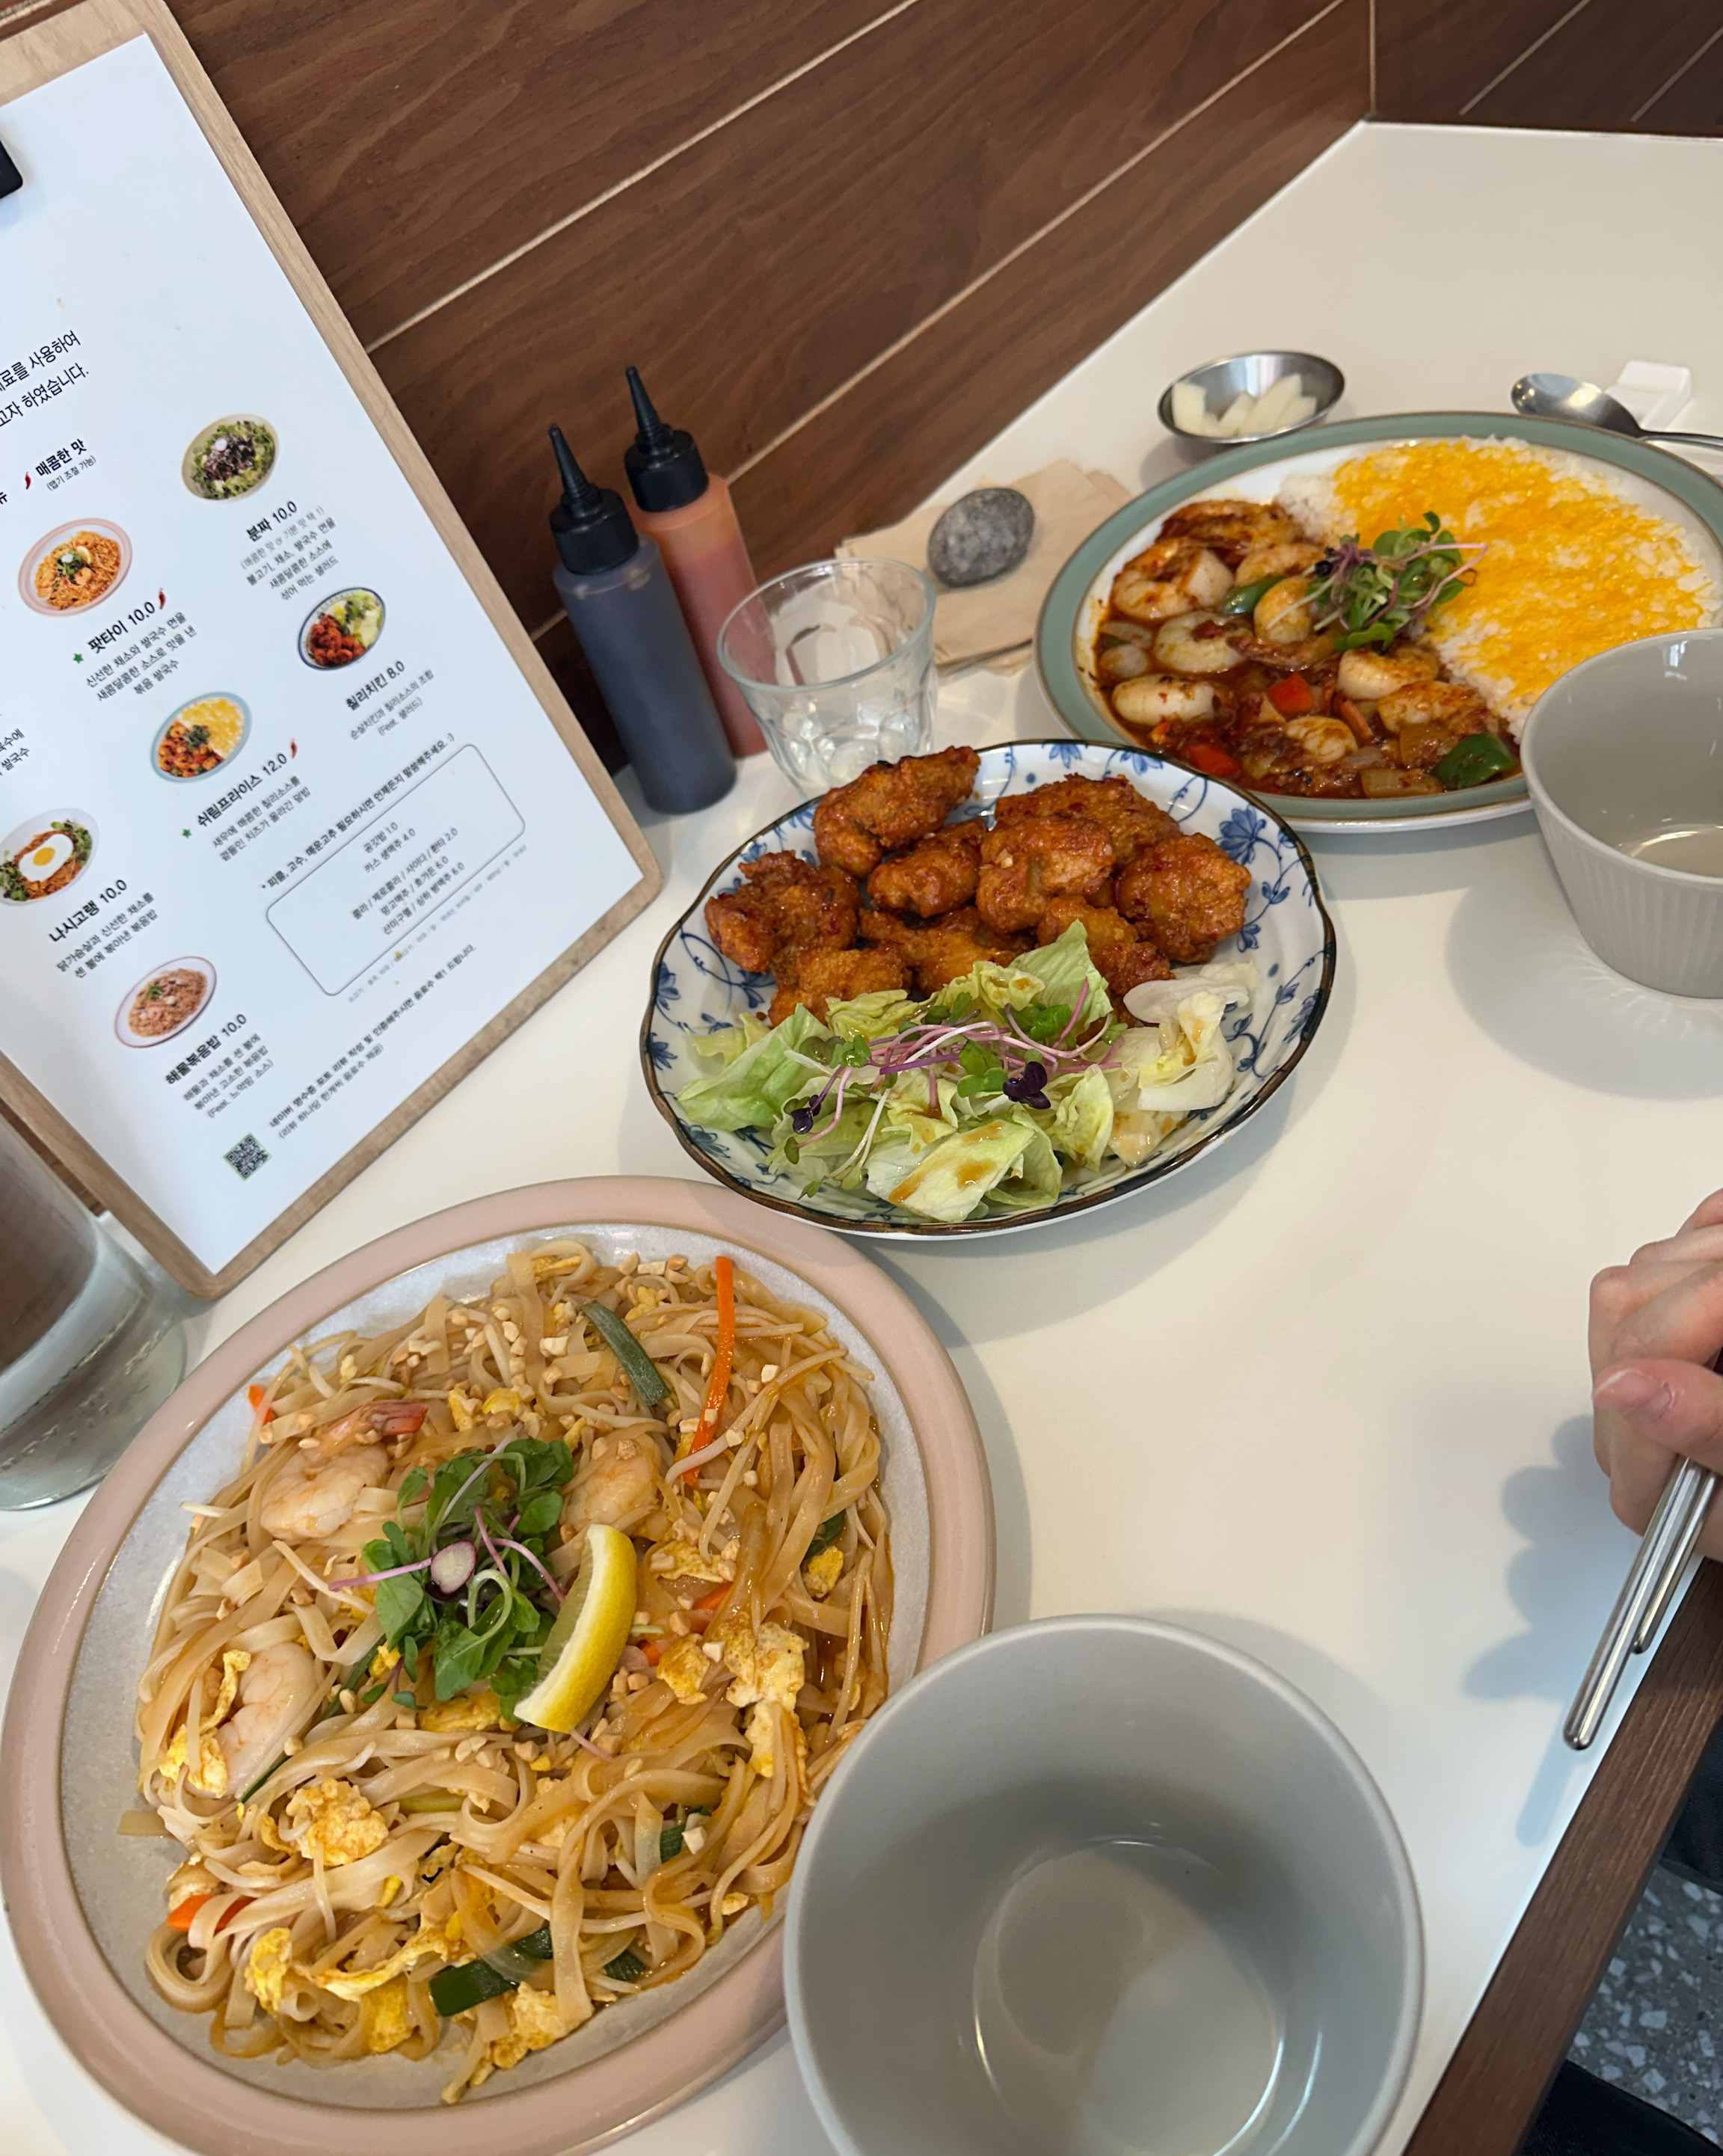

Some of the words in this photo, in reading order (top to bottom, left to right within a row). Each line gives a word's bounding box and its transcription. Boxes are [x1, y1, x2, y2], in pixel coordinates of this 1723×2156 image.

[0, 361, 30, 392] 료를
[28, 330, 82, 369] 사용하여
[21, 362, 89, 408] 하였습니다.
[34, 447, 73, 476] 매콤한
[70, 438, 87, 455] 맛
[46, 475, 66, 491] (맵기
[64, 465, 80, 481] 조절
[79, 455, 96, 470] 가능)
[246, 517, 273, 542] 분짜
[272, 500, 298, 523] 10.0
[264, 541, 276, 553] 맛
[282, 523, 299, 539] 기본
[296, 517, 308, 530] 맛
[246, 562, 276, 586] 불고기,
[293, 530, 318, 552] 쌀국수
[317, 517, 337, 535] 면을
[269, 556, 309, 589] 새콤달콤한
[309, 539, 333, 562] 소스에
[280, 583, 299, 601] 섞어
[296, 574, 316, 588] 먹는
[314, 556, 339, 577] 샐러드
[86, 663, 114, 688] 신선한
[113, 644, 142, 668] 채소와
[140, 627, 168, 649] 쌀국수
[166, 612, 187, 630] 면을
[87, 620, 129, 654] 팟타이
[127, 601, 156, 626] 10.0
[96, 666, 141, 701] 새콤달콤한
[141, 647, 168, 671] 소스로
[165, 633, 186, 652] 맛을
[183, 624, 197, 638] 낸
[133, 678, 154, 695] 볶음
[152, 660, 179, 682] 쌀국수
[345, 673, 389, 711] 칠리치킨
[386, 660, 405, 679] 8.0
[350, 707, 386, 740] 순살치킨과
[384, 681, 420, 713] 칠리소스의
[0, 747, 30, 771] 쌀국수
[197, 775, 263, 827] 쉬림프라이스
[262, 752, 287, 776] 12.0
[212, 825, 239, 848] 새우에
[236, 805, 263, 828] 매콤한
[261, 776, 301, 810] 칠리소스를
[245, 819, 271, 842] 치즈가
[268, 799, 295, 823] 올라간
[292, 786, 311, 804] 덮밥
[266, 870, 289, 888] 피클,
[286, 856, 308, 873] 고수,
[304, 829, 337, 856] 매운고추
[335, 797, 375, 832] 필요하시면
[372, 773, 405, 802] 언제든지
[363, 858, 382, 873] 카스
[380, 838, 402, 861] 생맥주
[402, 828, 416, 841] 4.0
[384, 821, 399, 835] 1.0
[405, 853, 428, 874] 사이다
[444, 827, 458, 842] 2.0
[49, 900, 100, 942] 나시고랭
[99, 879, 127, 903] 10.0
[56, 934, 102, 972] 닭가슴살과
[101, 912, 129, 938] 신선한
[126, 892, 155, 916] 채소를
[74, 966, 87, 979] 센
[85, 950, 106, 970] 불에
[102, 930, 132, 954] 볶아낸
[129, 909, 159, 933] 볶음밥
[165, 1034, 222, 1084] 해물볶음밥
[221, 1013, 247, 1037] 10.0
[219, 1066, 245, 1090] 고소한
[242, 1045, 269, 1068] 볶음밥
[255, 1058, 274, 1079] 소스)
[182, 1078, 210, 1101] 해물과
[208, 1057, 234, 1080] 채소를
[268, 1105, 295, 1128] 네이버
[316, 1071, 334, 1087] 포토
[332, 1056, 348, 1072] 리뷰
